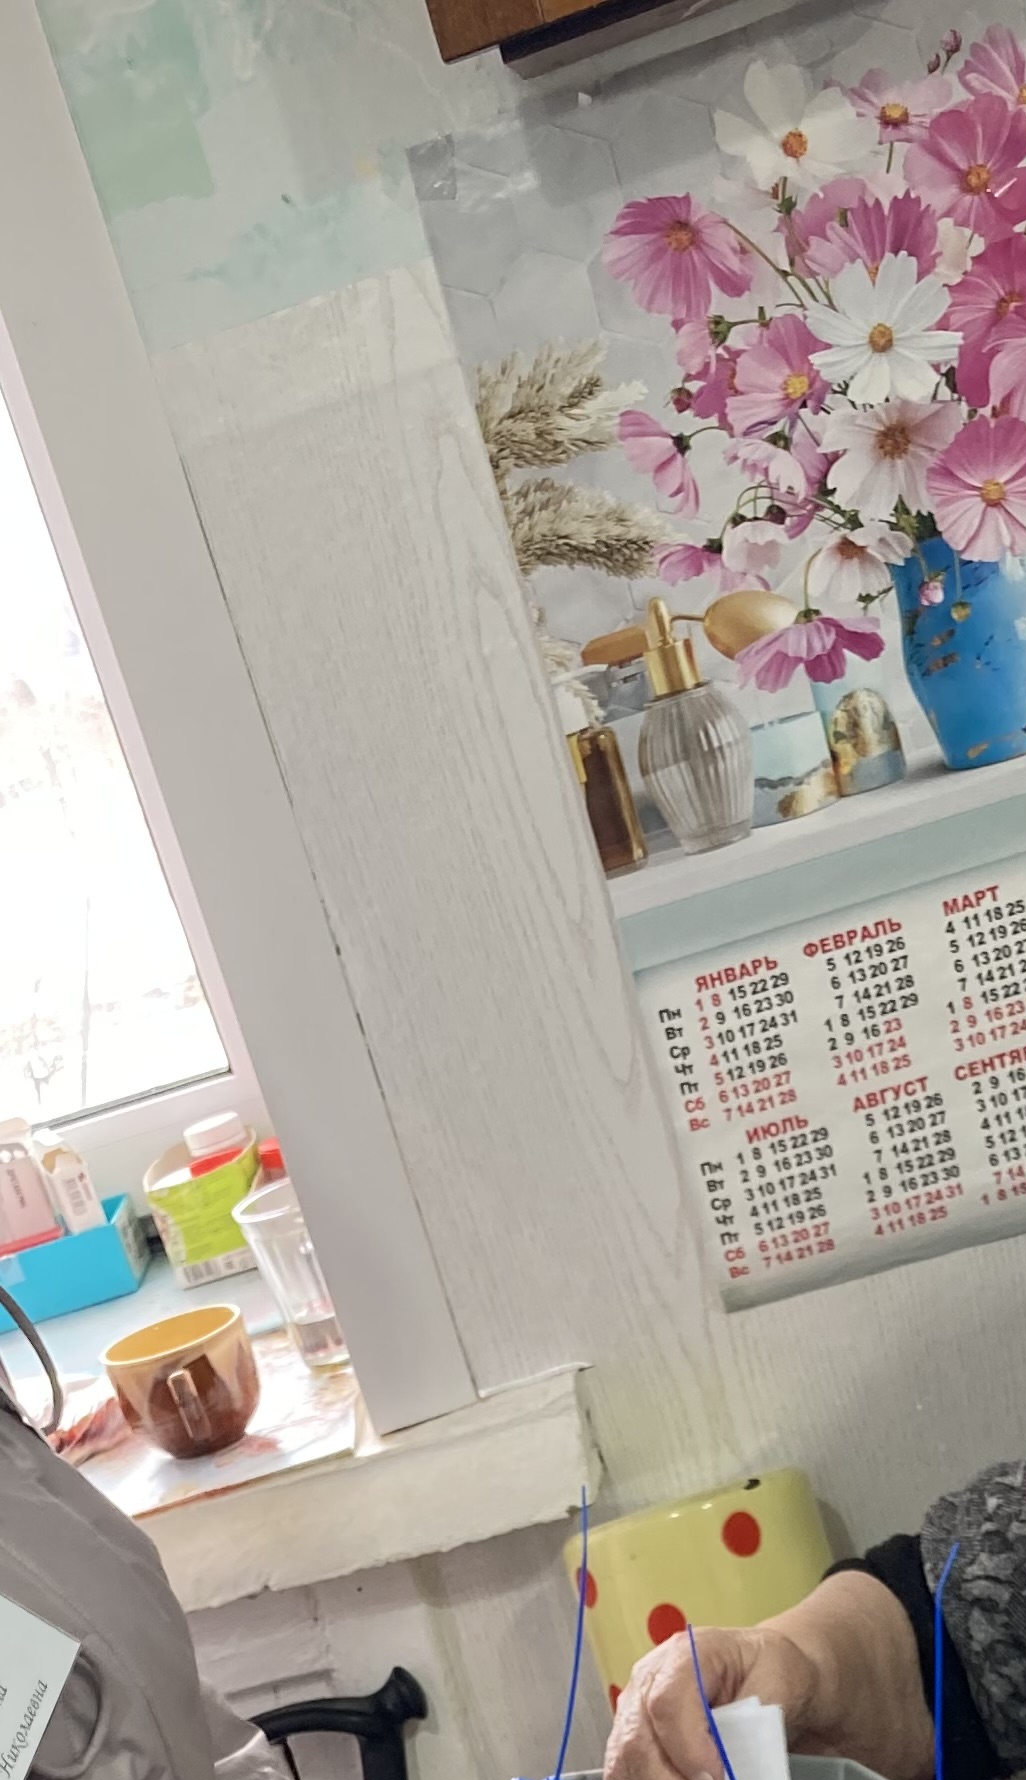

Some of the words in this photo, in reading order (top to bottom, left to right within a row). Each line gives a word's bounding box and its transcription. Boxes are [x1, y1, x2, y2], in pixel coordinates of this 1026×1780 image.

[942, 885, 999, 917] МАРТ
[945, 921, 955, 934] 4
[962, 913, 981, 930] 11
[985, 906, 1004, 923] 18
[1006, 899, 1026, 917] 25
[803, 918, 902, 958] ФЕВРАЛЬ
[826, 957, 837, 972] 5
[844, 950, 863, 966] 12
[865, 943, 884, 959] 19
[885, 936, 905, 954] 26
[949, 939, 960, 954] 5
[967, 931, 987, 948] 12
[989, 924, 1008, 941] 19
[695, 956, 778, 993] ЯНВАРЬ
[830, 976, 841, 990] 6
[848, 968, 867, 984] 13
[868, 961, 888, 979] 20
[890, 954, 908, 972] 27
[954, 959, 964, 973] 6
[972, 951, 991, 967] 13
[992, 944, 1012, 962] 20
[834, 994, 844, 1009] 7
[853, 987, 872, 1003] 14
[873, 981, 892, 998] 21
[895, 974, 915, 991] 28
[957, 977, 967, 992] 7
[976, 969, 995, 986] 14
[996, 963, 1015, 980] 21
[658, 1008, 682, 1023] Пн
[695, 998, 704, 1012] 1
[711, 993, 722, 1007] 8
[728, 984, 747, 1001] 15
[749, 978, 770, 996] 22
[769, 972, 789, 989] 29
[665, 1026, 683, 1041] Вт
[699, 1016, 710, 1031] 2
[715, 1011, 726, 1025] 9
[733, 1003, 752, 1019] 16
[753, 996, 773, 1014] 23
[774, 990, 794, 1007] 30
[824, 1018, 833, 1032] 1
[840, 1013, 850, 1028] 8
[857, 1005, 876, 1021] 15
[878, 999, 898, 1016] 22
[899, 992, 919, 1009] 29
[669, 1045, 691, 1060] Ср
[703, 1035, 715, 1050] 3
[717, 1029, 736, 1045] 10
[738, 1022, 755, 1039] 17
[759, 1015, 778, 1033] 24
[779, 1009, 798, 1027] 31
[674, 1063, 693, 1076] Чт
[710, 1053, 720, 1066] 4
[721, 1047, 739, 1063] 11
[743, 1040, 762, 1057] 18
[763, 1034, 783, 1051] 25
[679, 1081, 699, 1095] Пт
[714, 1071, 724, 1086] 5
[726, 1066, 746, 1081] 12
[748, 1059, 766, 1074] 19
[768, 1052, 788, 1069] 26
[684, 1096, 706, 1113] Сб
[718, 1090, 729, 1104] 6
[732, 1083, 750, 1099] 13
[752, 1077, 771, 1094] 20
[773, 1070, 791, 1088] 27
[972, 1081, 982, 1095] 2
[989, 1075, 1000, 1089] 9
[1008, 1067, 1026, 1083] 16
[688, 1118, 710, 1132] Вс
[723, 1107, 732, 1121] 7
[736, 1101, 755, 1117] 14
[757, 1095, 775, 1112] 21
[778, 1088, 797, 1105] 28
[853, 1076, 928, 1113] АВГУСТ
[865, 1113, 875, 1127] 5
[882, 1105, 901, 1121] 12
[903, 1099, 922, 1115] 19
[923, 1093, 943, 1109] 26
[976, 1098, 987, 1113] 3
[989, 1092, 1008, 1108] 10
[745, 1115, 809, 1144] ИЮЛЬ
[869, 1130, 880, 1145] 6
[887, 1123, 905, 1139] 13
[907, 1117, 926, 1133] 20
[928, 1110, 946, 1127] 27
[700, 1161, 723, 1176] Пн
[736, 1152, 745, 1165] 1
[752, 1147, 762, 1161] 8
[769, 1139, 788, 1155] 15
[790, 1133, 809, 1150] 22
[809, 1127, 829, 1143] 29
[706, 1179, 724, 1193] Вт
[740, 1169, 750, 1183] 2
[756, 1164, 767, 1178] 9
[774, 1156, 792, 1172] 16
[793, 1150, 813, 1167] 23
[815, 1144, 833, 1161] 30
[710, 1197, 732, 1211] Ср
[744, 1188, 755, 1202] 3
[757, 1182, 776, 1197] 10
[778, 1175, 795, 1191] 17
[798, 1169, 817, 1186] 24
[818, 1163, 837, 1180] 31
[715, 1214, 734, 1226] Чт
[720, 1231, 739, 1246] Пт
[724, 1246, 746, 1262] Сб
[728, 1266, 750, 1279] Вс
[0, 1679, 48, 1780] Николаевна
